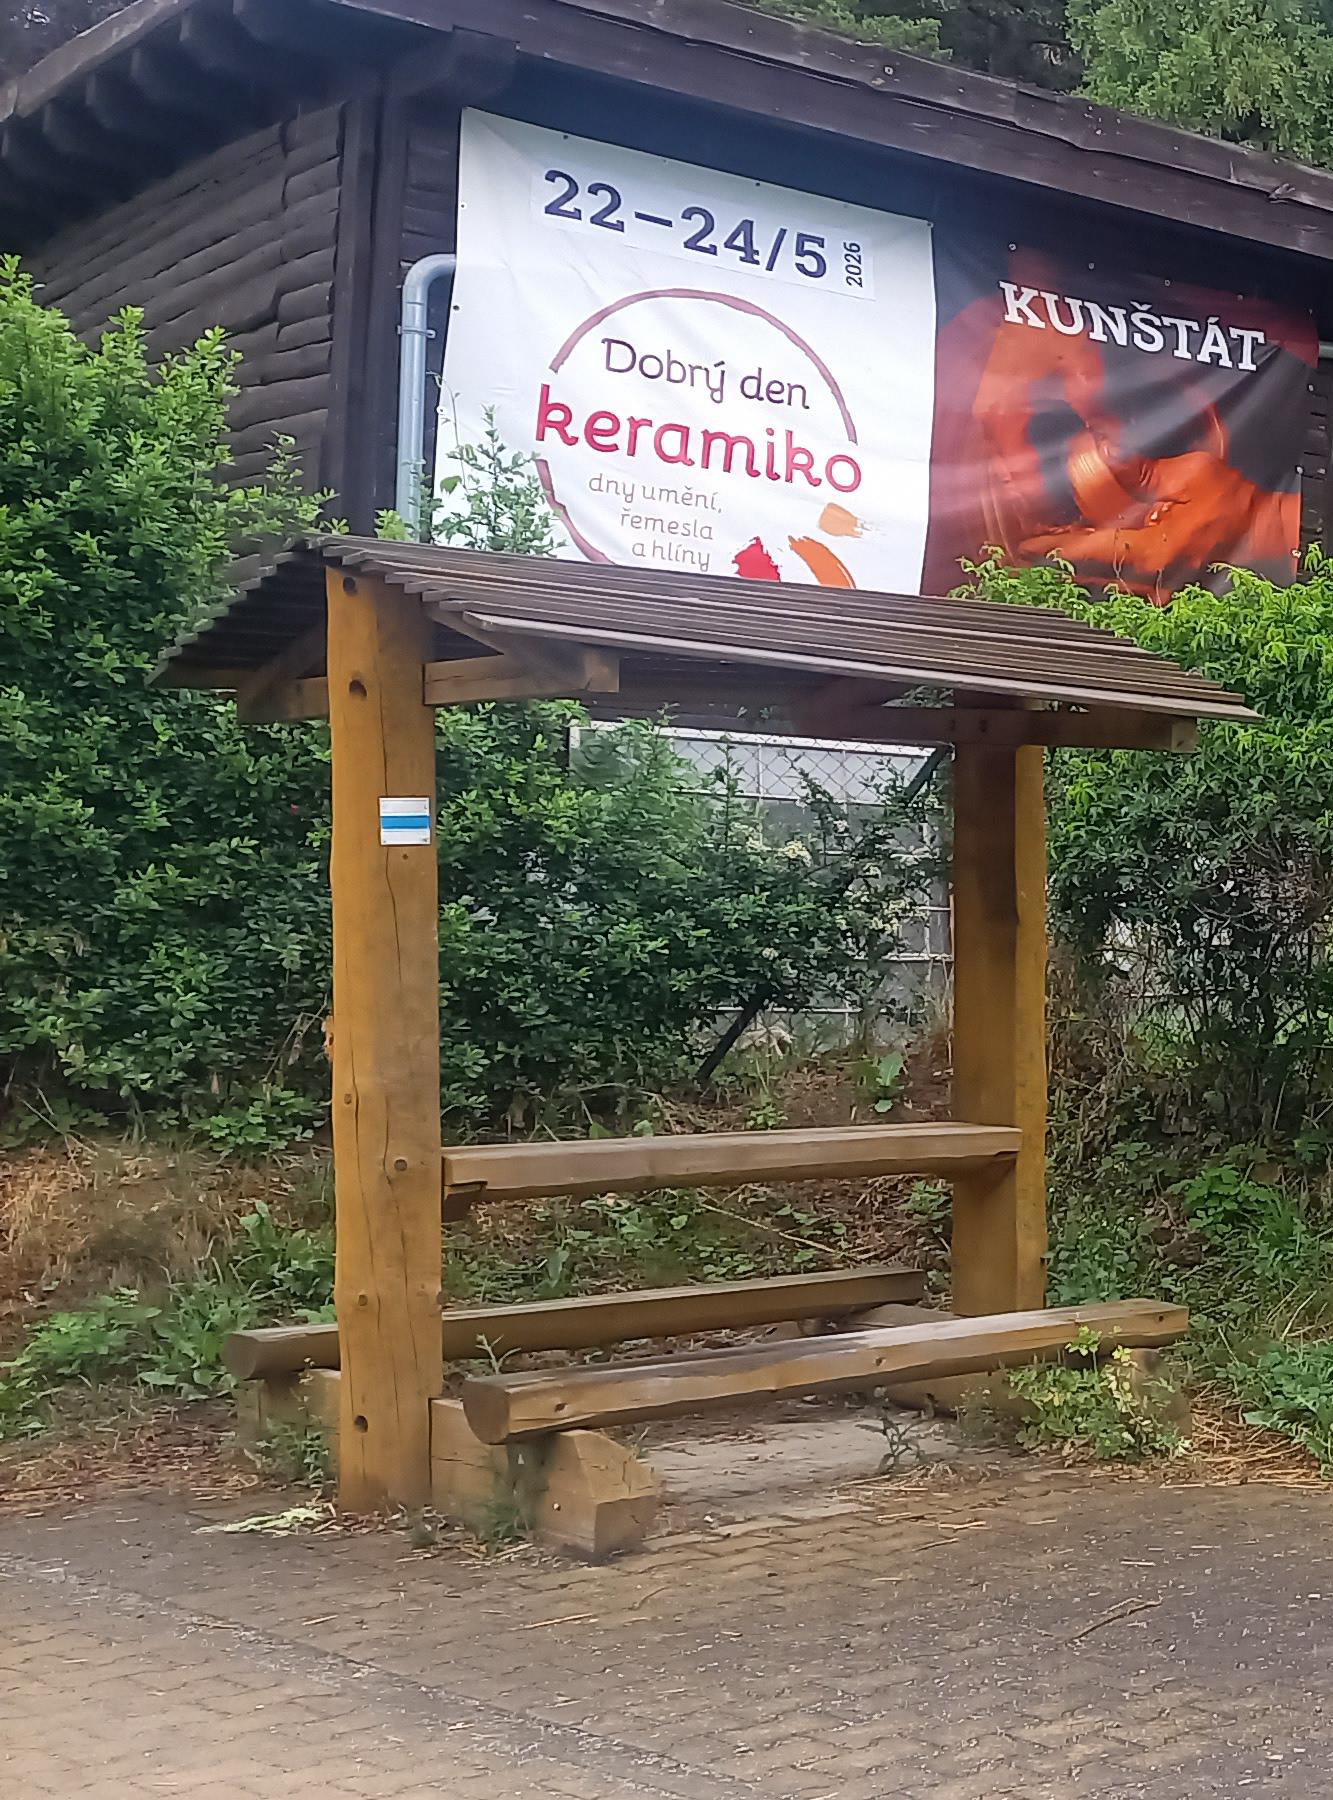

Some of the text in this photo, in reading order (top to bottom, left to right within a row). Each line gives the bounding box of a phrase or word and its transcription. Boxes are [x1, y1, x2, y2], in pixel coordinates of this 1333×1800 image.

[843, 242, 863, 288] 2026
[999, 281, 1265, 371] KUNŠTÁT
[600, 338, 810, 410] Dobrý den
[535, 383, 862, 493] keramiko
[588, 473, 722, 514] dny umění,
[621, 507, 713, 540] řemesla
[632, 540, 711, 573] a hlíny
